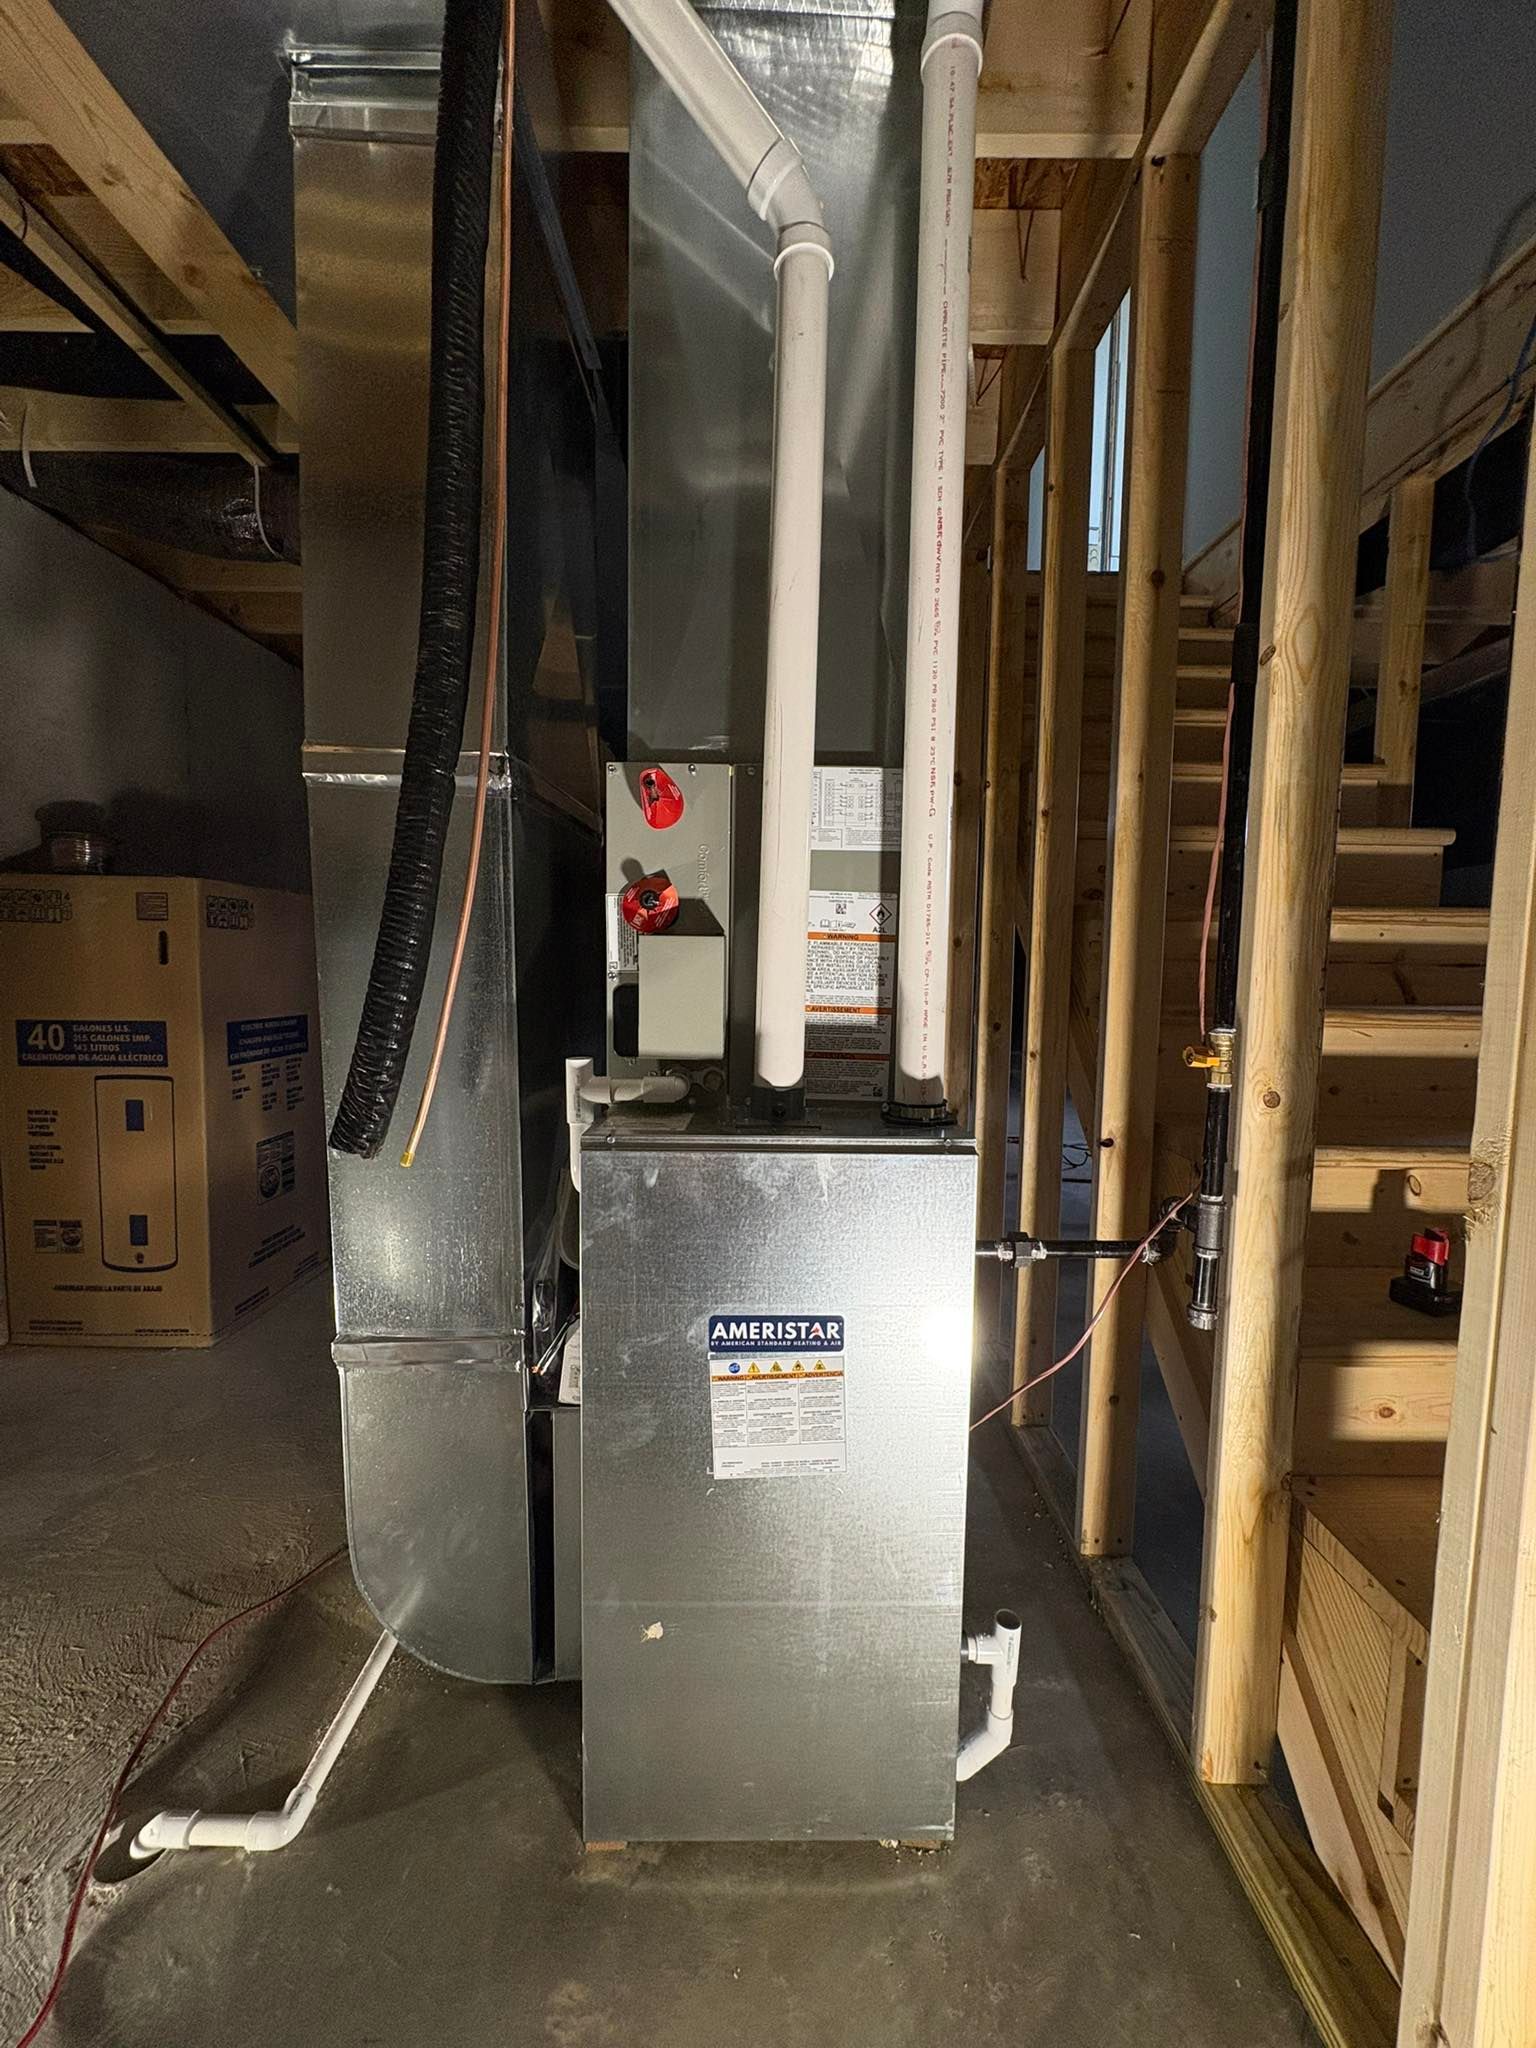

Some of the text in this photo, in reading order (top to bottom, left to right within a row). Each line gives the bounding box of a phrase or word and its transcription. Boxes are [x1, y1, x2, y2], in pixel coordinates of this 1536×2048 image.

[941, 301, 949, 348] CHARLOTTE
[938, 430, 946, 446] PVC
[932, 640, 940, 656] PVC
[926, 858, 934, 876] Code
[811, 1005, 860, 1014] AVERTISSEMENT
[72, 1024, 130, 1032] GALONES U.S.
[27, 1023, 65, 1051] 40
[90, 1034, 130, 1042] GALONES
[90, 1044, 120, 1052] LITROS
[22, 1052, 76, 1061] CALENTADOR
[92, 1054, 116, 1062] AGUA
[711, 1322, 841, 1340] AMERISTAR
[718, 1374, 744, 1382] WARNING
